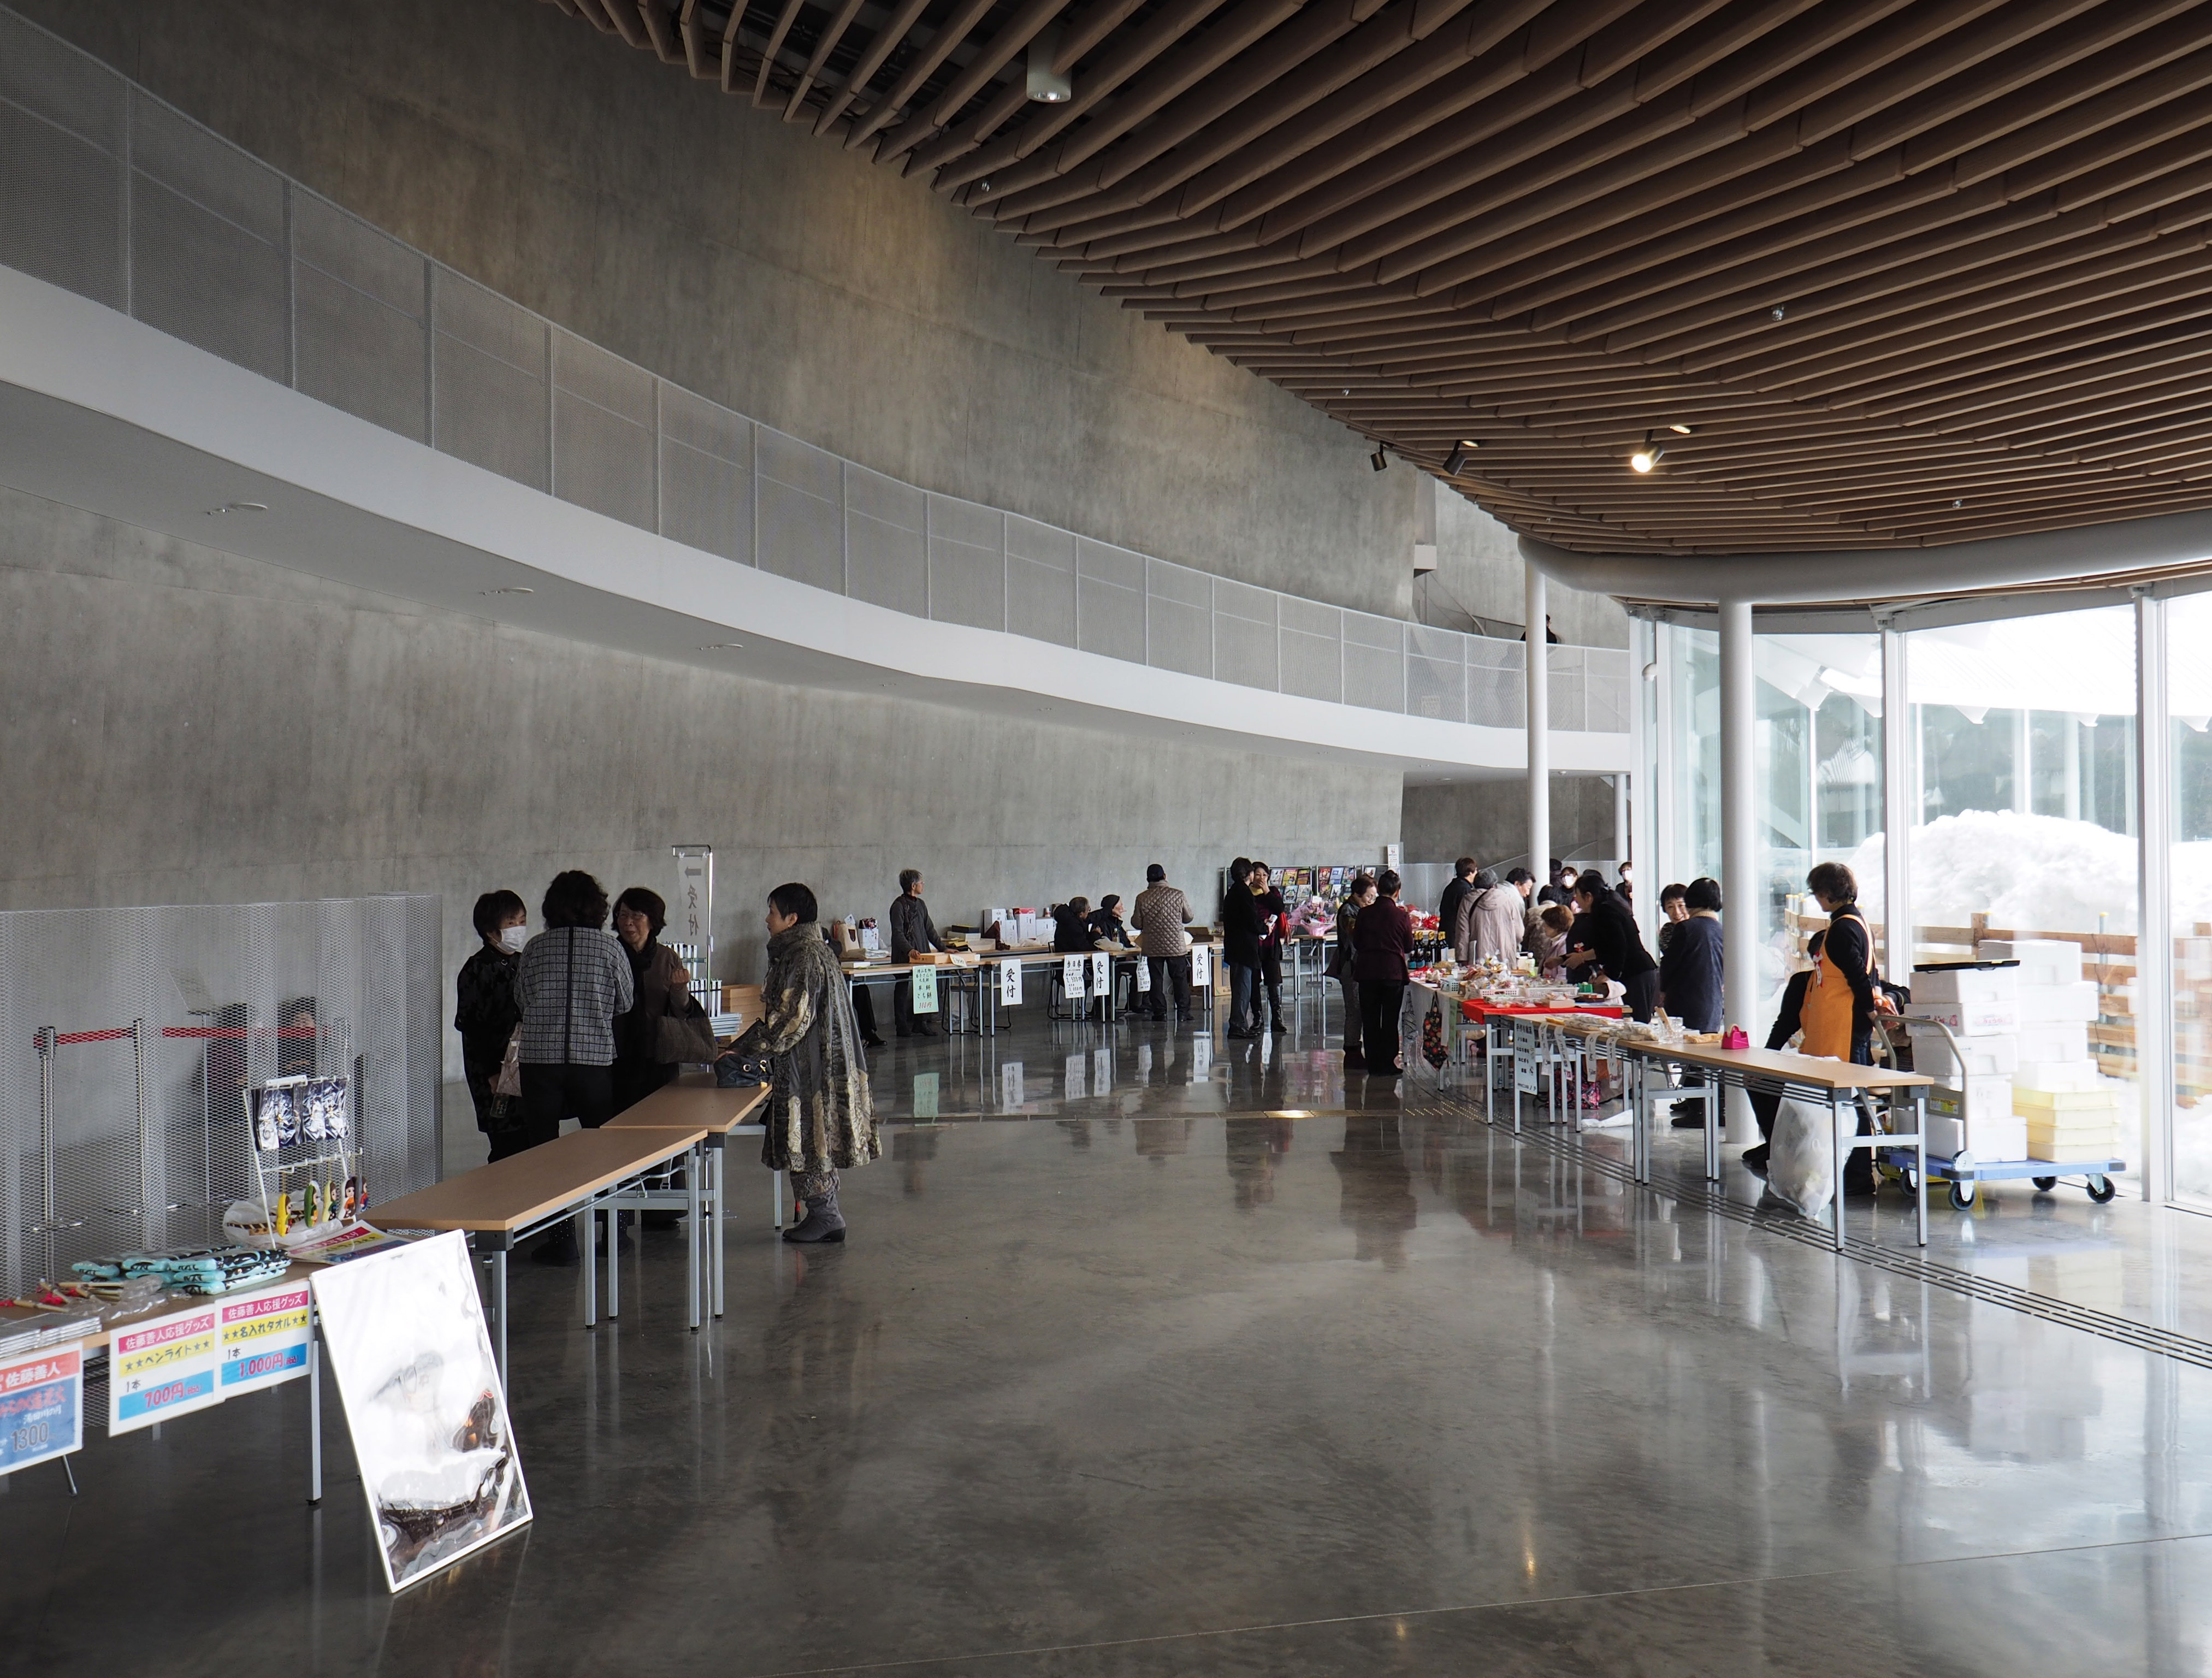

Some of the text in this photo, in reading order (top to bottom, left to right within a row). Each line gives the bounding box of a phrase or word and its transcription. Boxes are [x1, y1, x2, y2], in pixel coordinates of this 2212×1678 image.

[1096, 960, 1104, 989] 受付
[1196, 953, 1204, 979] 受付
[1006, 968, 1016, 998] 受付
[228, 1293, 303, 1320] 佐藤善人応援グッズ
[125, 1316, 210, 1351] 佐藤善人応援グッズ
[228, 1347, 241, 1360] 1本
[126, 1379, 141, 1393] 1本
[144, 1382, 185, 1409] 700円
[11, 1421, 49, 1452] 1300
